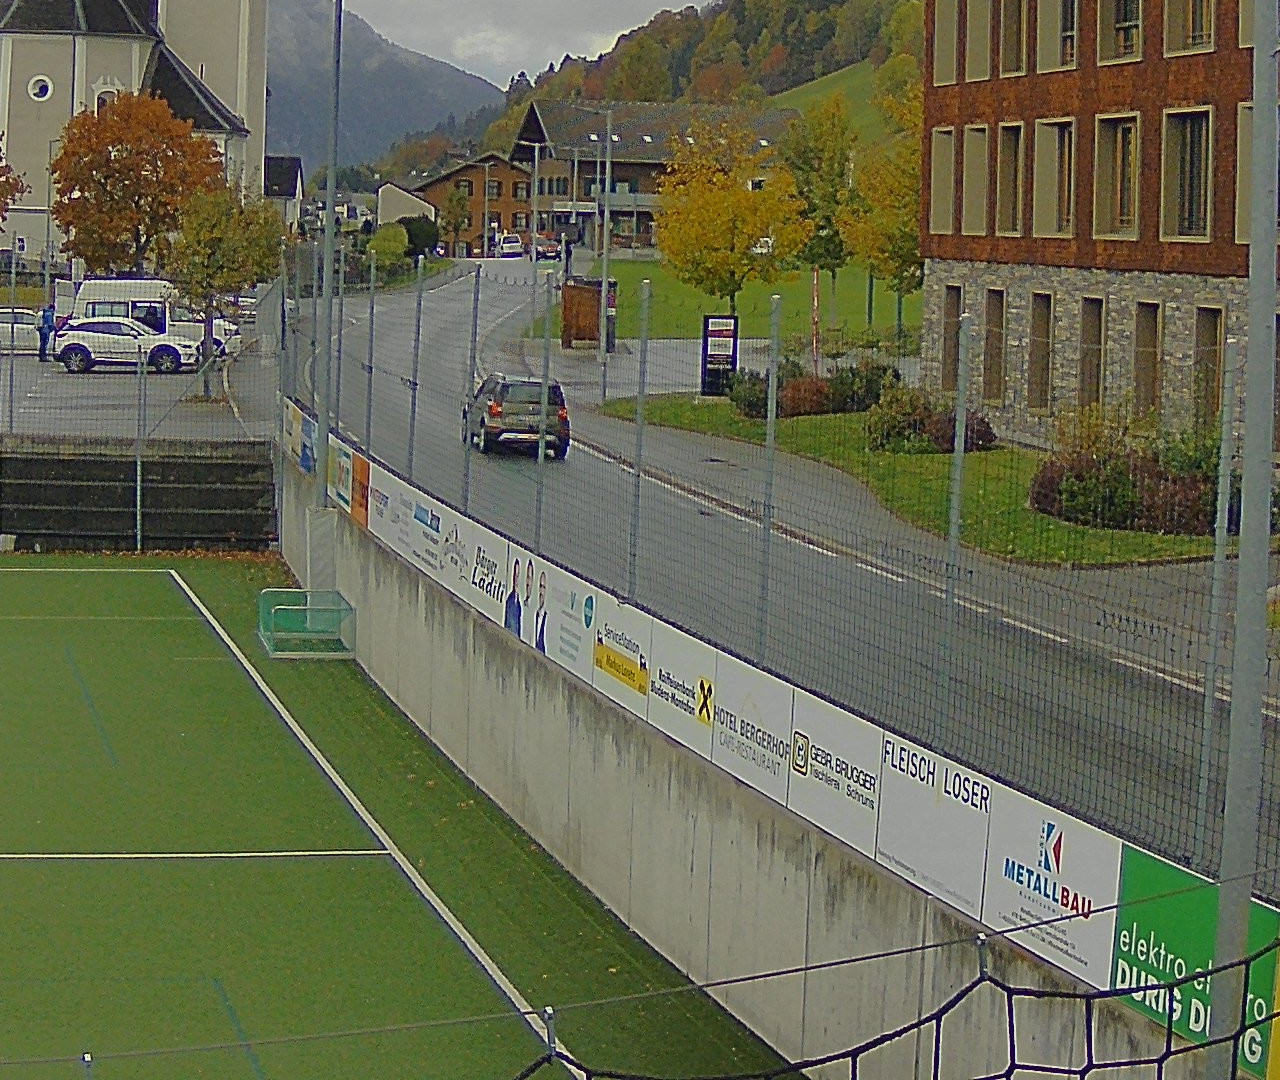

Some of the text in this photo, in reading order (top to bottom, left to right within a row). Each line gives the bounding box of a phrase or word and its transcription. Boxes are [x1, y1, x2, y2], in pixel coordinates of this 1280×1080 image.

[658, 668, 696, 700] Raiffeisenbank
[713, 705, 791, 761] HOTEL BERGERHOF
[810, 745, 877, 794] GEBR. BRUGGER
[810, 762, 875, 810] Tischlerei Schruns
[883, 740, 991, 814] FLEISCH LOSER
[1003, 857, 1093, 919] METALLBAU
[1119, 922, 1187, 978] elektro
